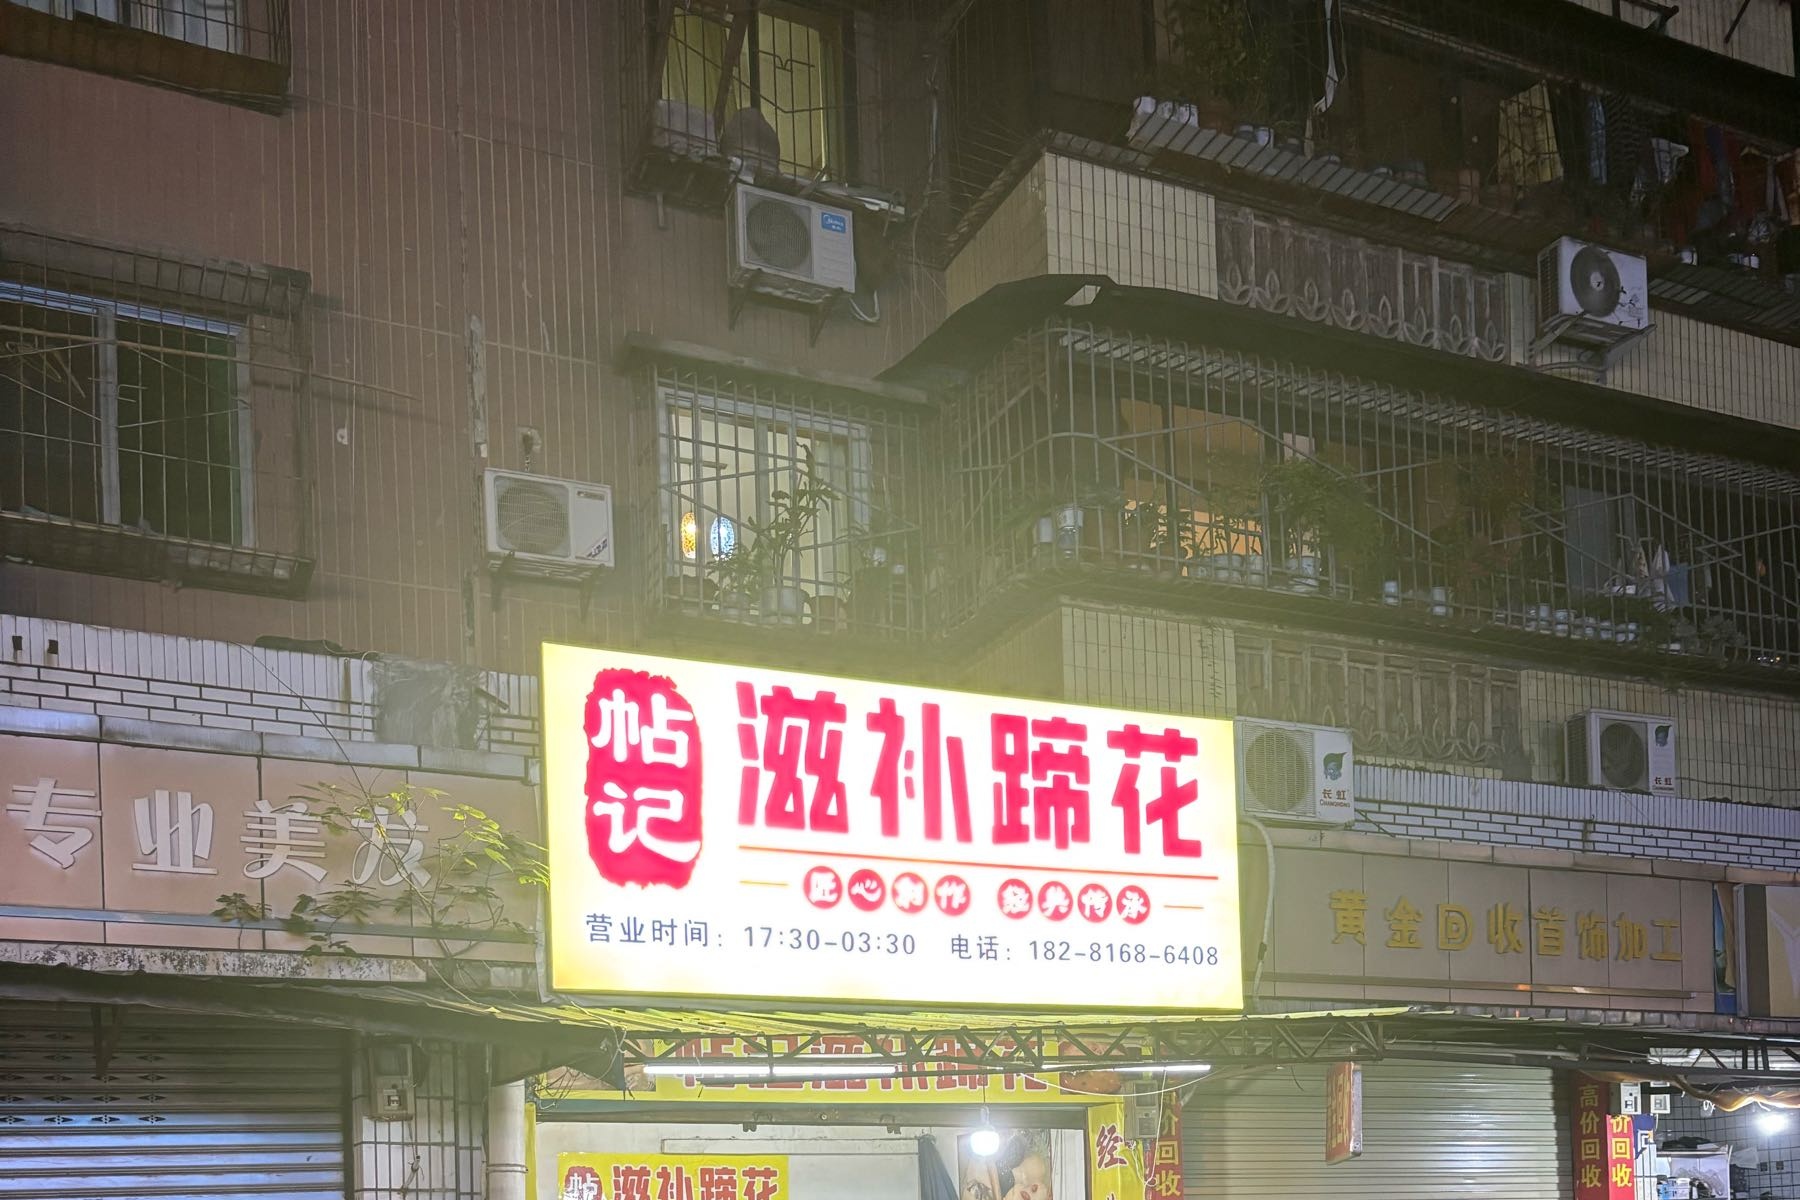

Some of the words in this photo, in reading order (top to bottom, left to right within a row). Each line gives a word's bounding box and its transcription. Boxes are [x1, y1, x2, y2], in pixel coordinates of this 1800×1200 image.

[587, 682, 703, 868] 帖记
[735, 679, 1203, 859] 滋补蹄花
[1321, 788, 1347, 800] 长虹
[5, 777, 432, 888] 专业美发
[743, 925, 917, 955] 17:30-03:30
[1028, 940, 1219, 966] 182-8168-6408
[1328, 889, 1683, 962] 黄金回收首饰加工
[1578, 1083, 1602, 1188] 高价回收
